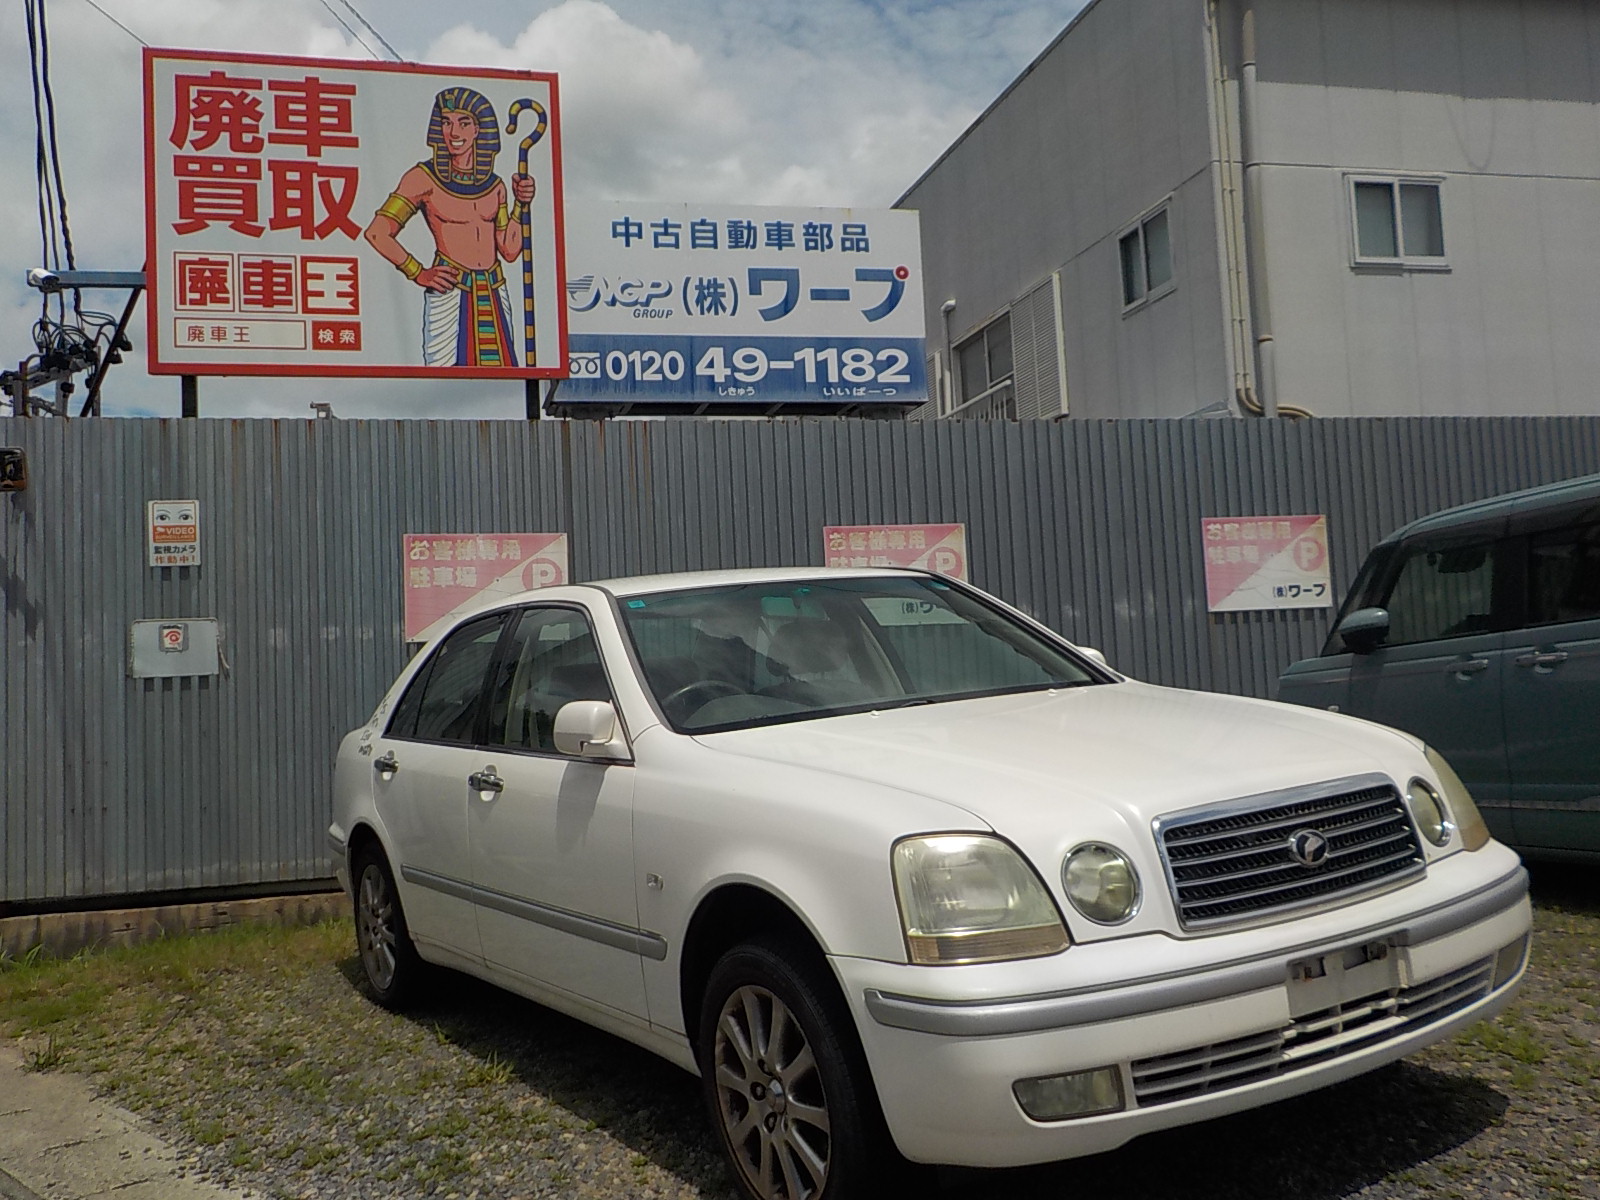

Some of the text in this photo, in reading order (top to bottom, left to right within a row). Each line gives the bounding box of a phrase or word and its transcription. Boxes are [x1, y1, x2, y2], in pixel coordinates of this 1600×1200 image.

[169, 71, 360, 157] 廃車
[171, 155, 363, 242] 買取
[611, 216, 871, 253] 中古自動車部品
[176, 254, 360, 315] 廃車王
[682, 265, 910, 323] (株)ワープ
[633, 308, 673, 319] GROUP
[186, 326, 251, 343] 廃車王
[317, 328, 356, 344] 検索
[605, 347, 911, 384] 0120 49-1182
[718, 386, 756, 397] しきゅう
[166, 526, 195, 535] VIDEO
[154, 545, 196, 554] 監視カメラ
[1300, 541, 1320, 568] P
[936, 552, 956, 573] P
[533, 564, 556, 588] P
[1272, 583, 1326, 598] (株)ワープ
